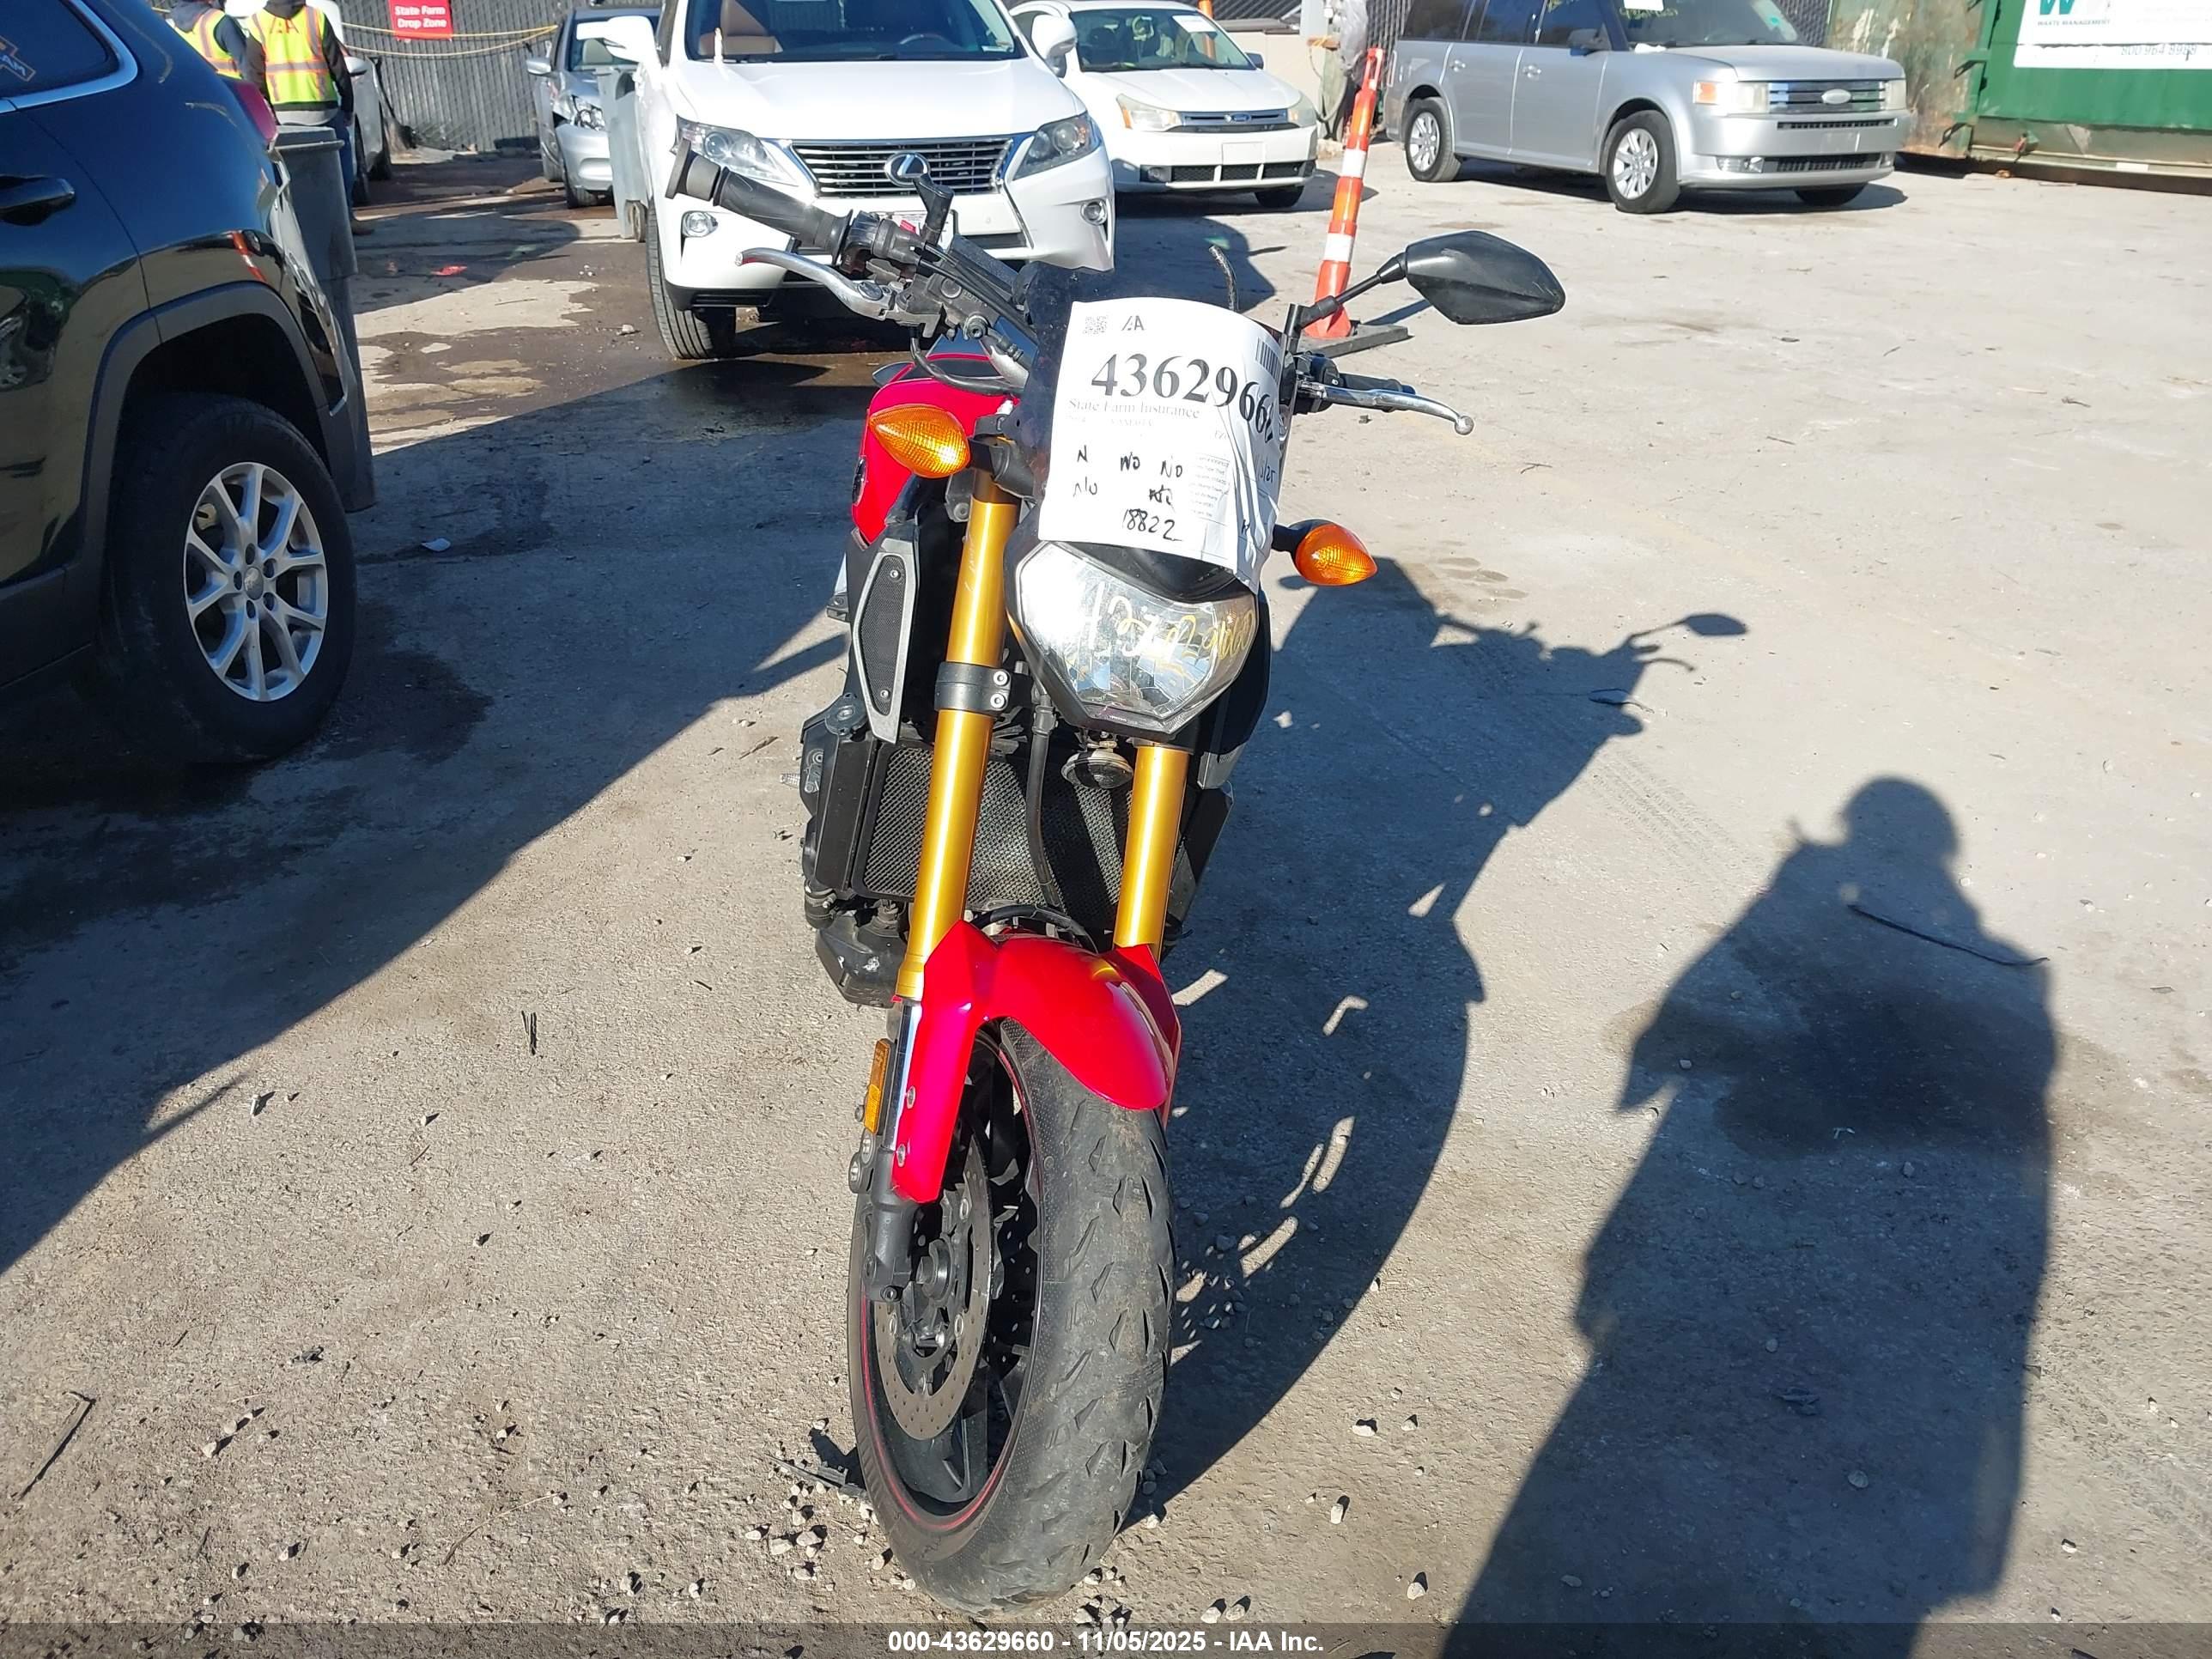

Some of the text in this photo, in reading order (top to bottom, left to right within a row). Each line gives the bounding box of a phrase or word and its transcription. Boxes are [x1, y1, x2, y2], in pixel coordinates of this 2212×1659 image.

[395, 5, 446, 15] State Farm
[398, 18, 447, 29] Drop Zone
[2121, 45, 2141, 56] 800
[1069, 398, 1200, 419] State Farm Insurance
[1122, 508, 1183, 542] 18822
